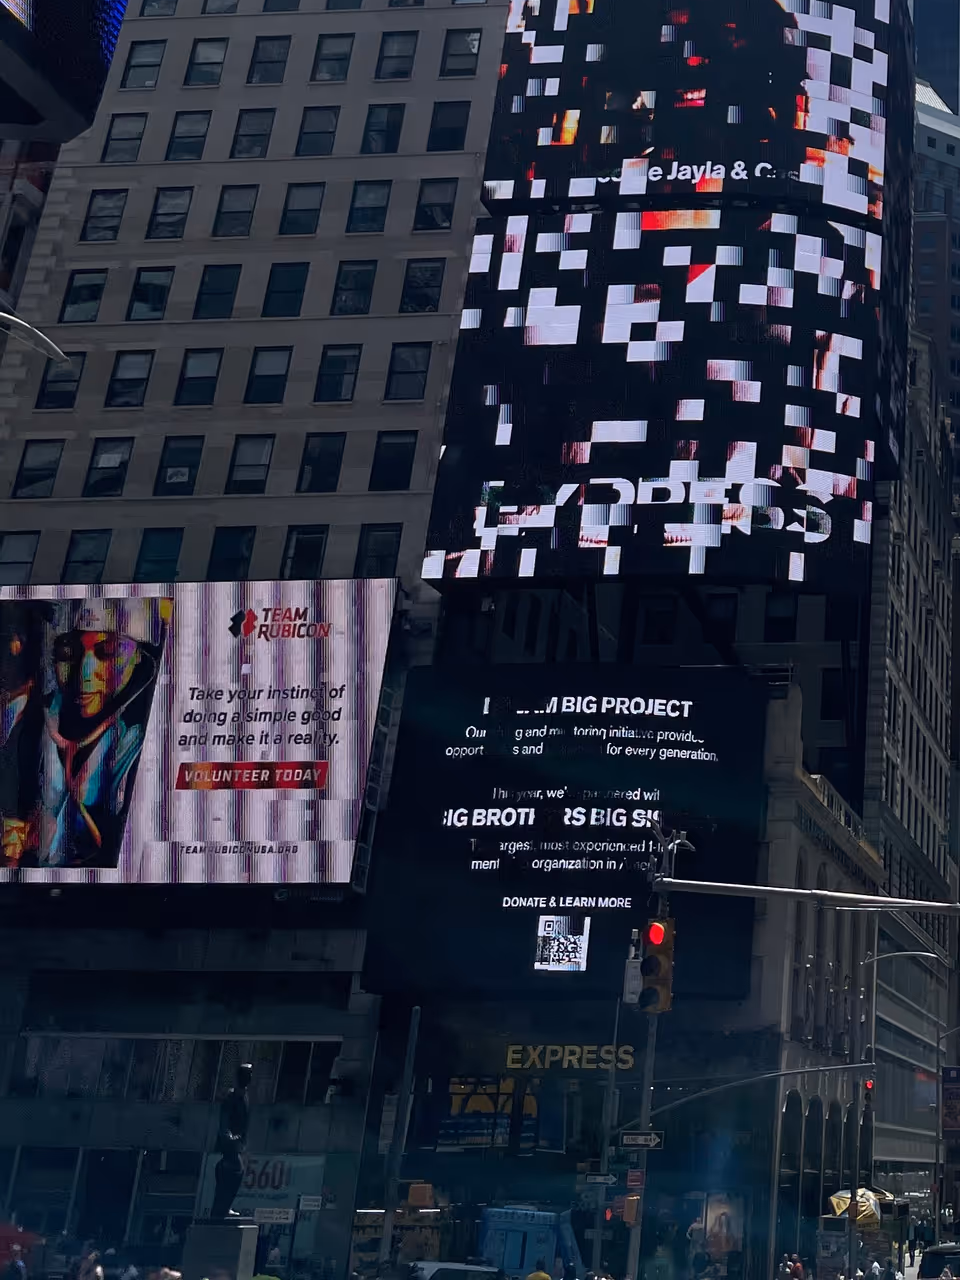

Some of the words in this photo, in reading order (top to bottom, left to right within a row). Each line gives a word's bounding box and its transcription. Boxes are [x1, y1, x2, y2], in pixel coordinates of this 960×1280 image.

[667, 161, 725, 184] Jayla
[730, 160, 748, 180] &
[262, 607, 308, 622] TEAM
[257, 622, 332, 641] RUBICON
[189, 687, 224, 701] Take
[227, 688, 263, 704] your
[267, 685, 327, 700] instinct
[329, 684, 346, 699] of
[561, 695, 598, 714] BIG
[601, 696, 693, 718] PROJECT
[183, 709, 227, 726] doing
[231, 712, 241, 722] a
[245, 708, 297, 725] simple
[301, 707, 342, 726] good
[178, 732, 208, 746] and
[211, 733, 255, 746] make
[259, 730, 270, 744] it
[273, 734, 282, 744] a
[288, 730, 339, 747] reality.
[525, 725, 548, 738] and
[521, 741, 544, 755] and
[606, 742, 623, 756] for
[624, 745, 656, 760] every
[184, 770, 270, 782] VOLUNTEER
[275, 769, 322, 781] TODAY
[589, 807, 627, 828] BIG
[531, 858, 604, 873] organization
[606, 860, 617, 870] in
[502, 896, 547, 908] DONATE
[548, 896, 557, 908] &
[559, 897, 596, 908] LEARN
[597, 897, 632, 908] MORE
[506, 1044, 635, 1070] EXPRESS
